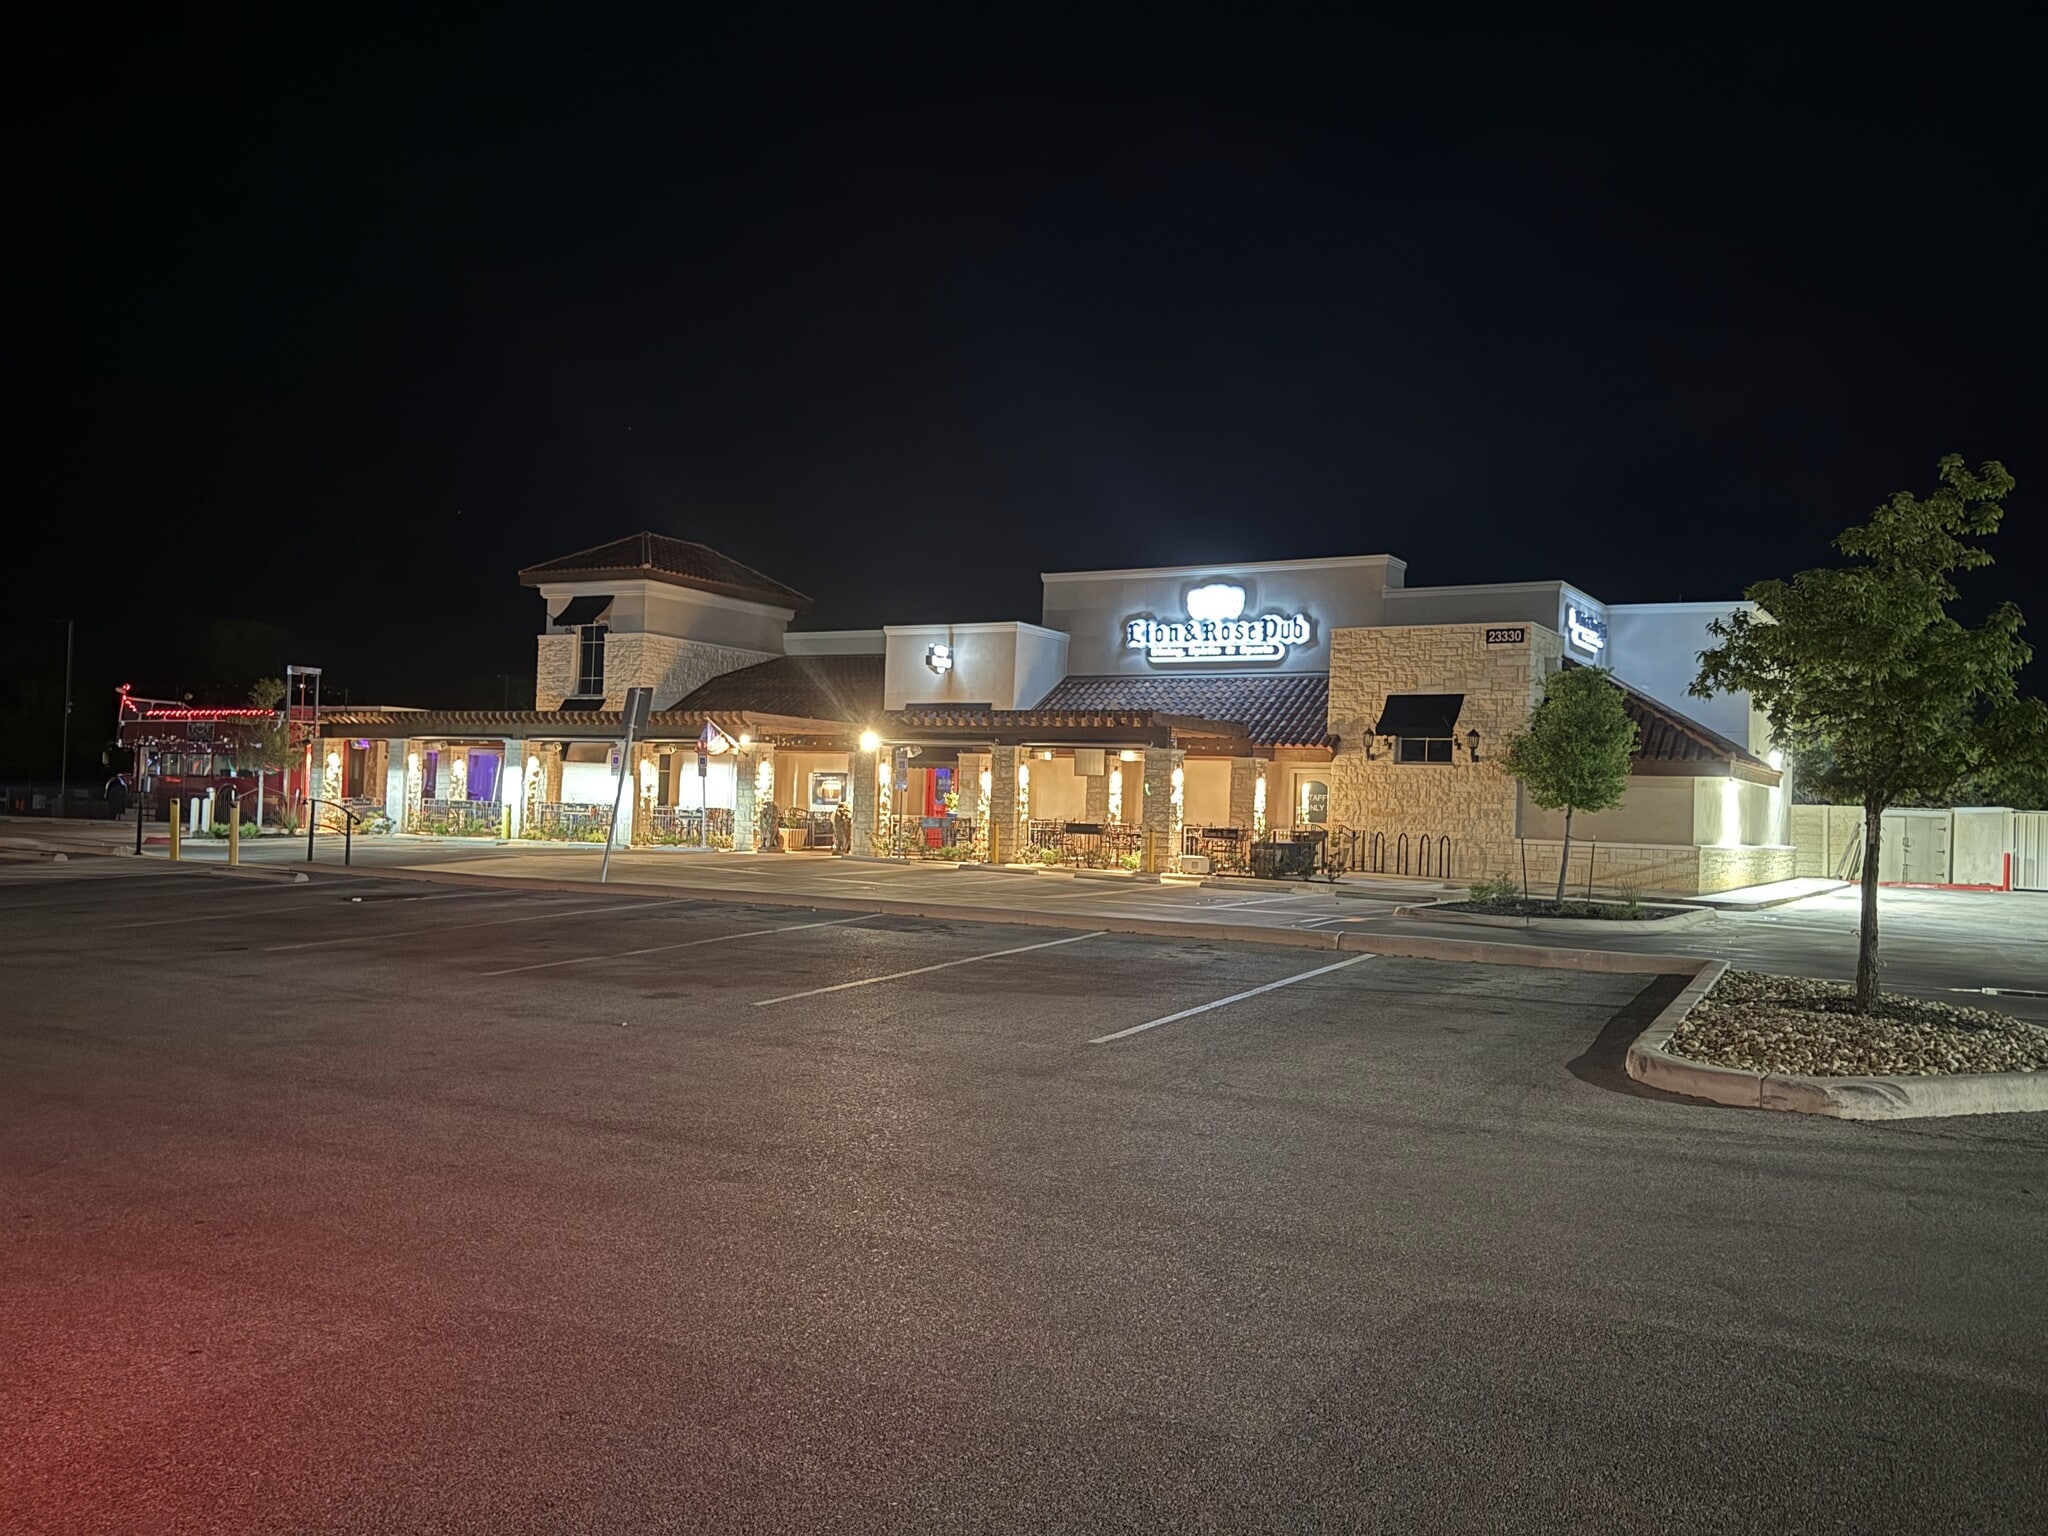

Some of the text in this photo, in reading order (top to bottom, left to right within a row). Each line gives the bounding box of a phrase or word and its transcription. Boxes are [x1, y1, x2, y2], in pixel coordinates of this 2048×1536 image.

[1202, 621, 1257, 642] Rose
[1260, 617, 1303, 642] Pub
[1488, 630, 1521, 642] 23330
[1307, 794, 1327, 802] TAFF
[1307, 804, 1325, 812] NLY
